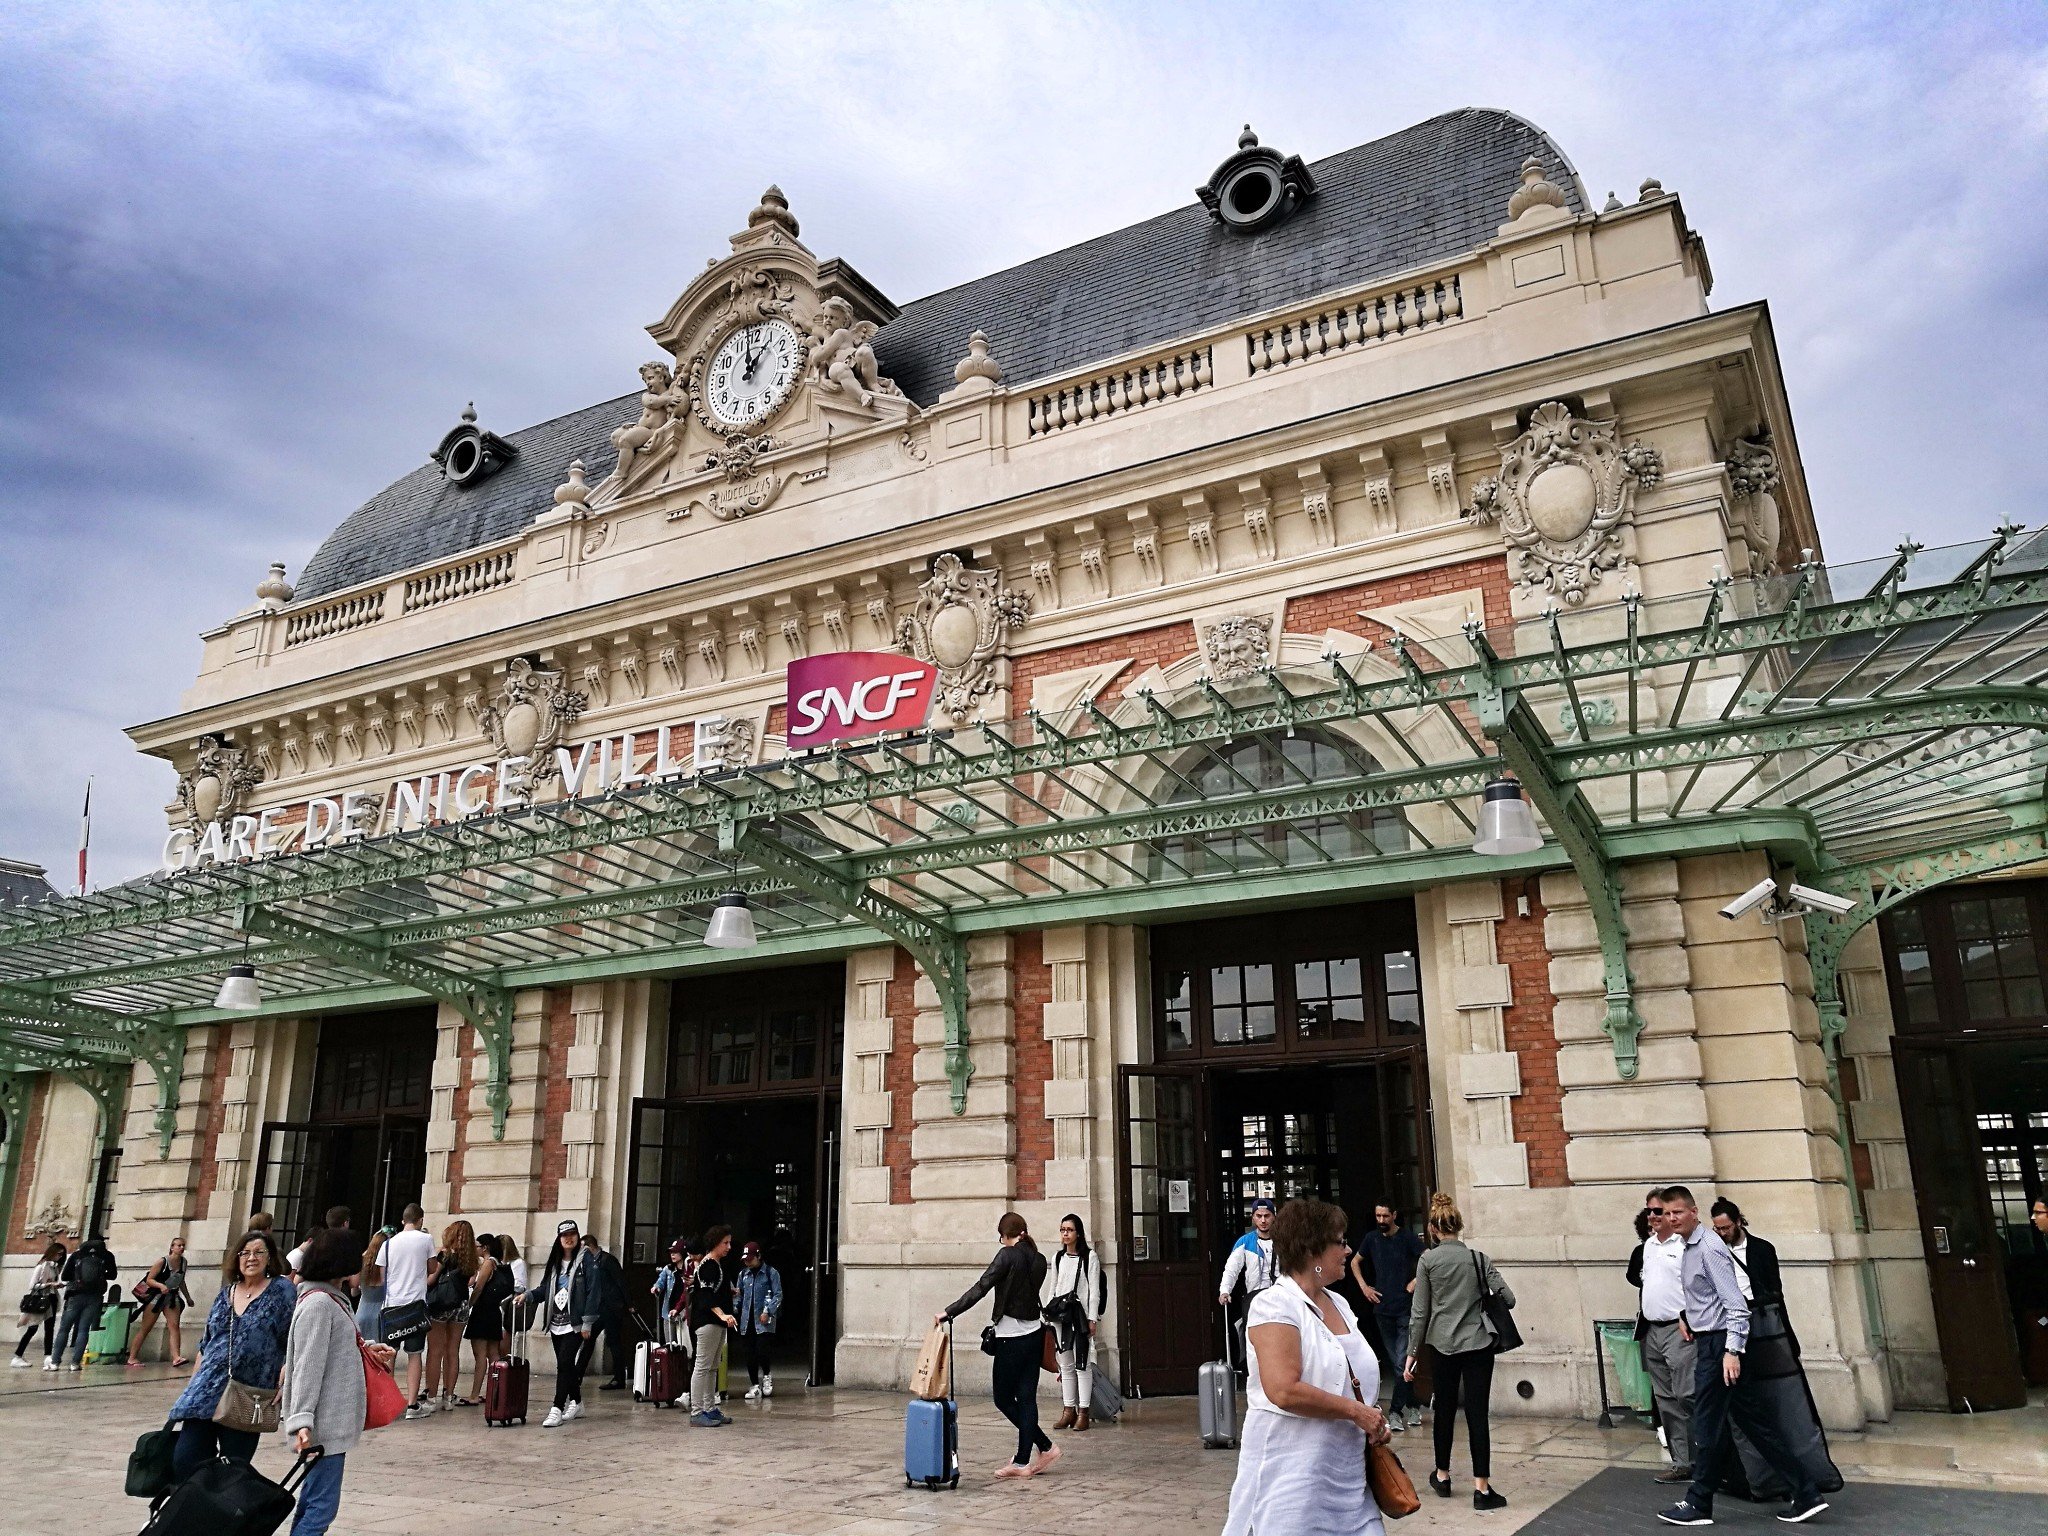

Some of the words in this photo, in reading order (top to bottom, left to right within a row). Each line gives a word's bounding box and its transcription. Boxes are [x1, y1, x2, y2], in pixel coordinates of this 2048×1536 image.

[736, 341, 744, 353] 11
[779, 339, 786, 352] 2
[722, 356, 732, 370] 10
[782, 356, 789, 368] 3
[718, 375, 725, 388] 9
[777, 374, 784, 387] 4
[721, 392, 728, 404] 8
[764, 391, 771, 404] 5
[733, 401, 739, 414] 7
[747, 401, 755, 414] 6
[791, 670, 925, 735] SNCF
[162, 807, 287, 871] GARE
[305, 789, 371, 845] DE
[394, 756, 533, 830] NICE
[556, 714, 728, 794] VILLE
[388, 1325, 418, 1340] adidas
